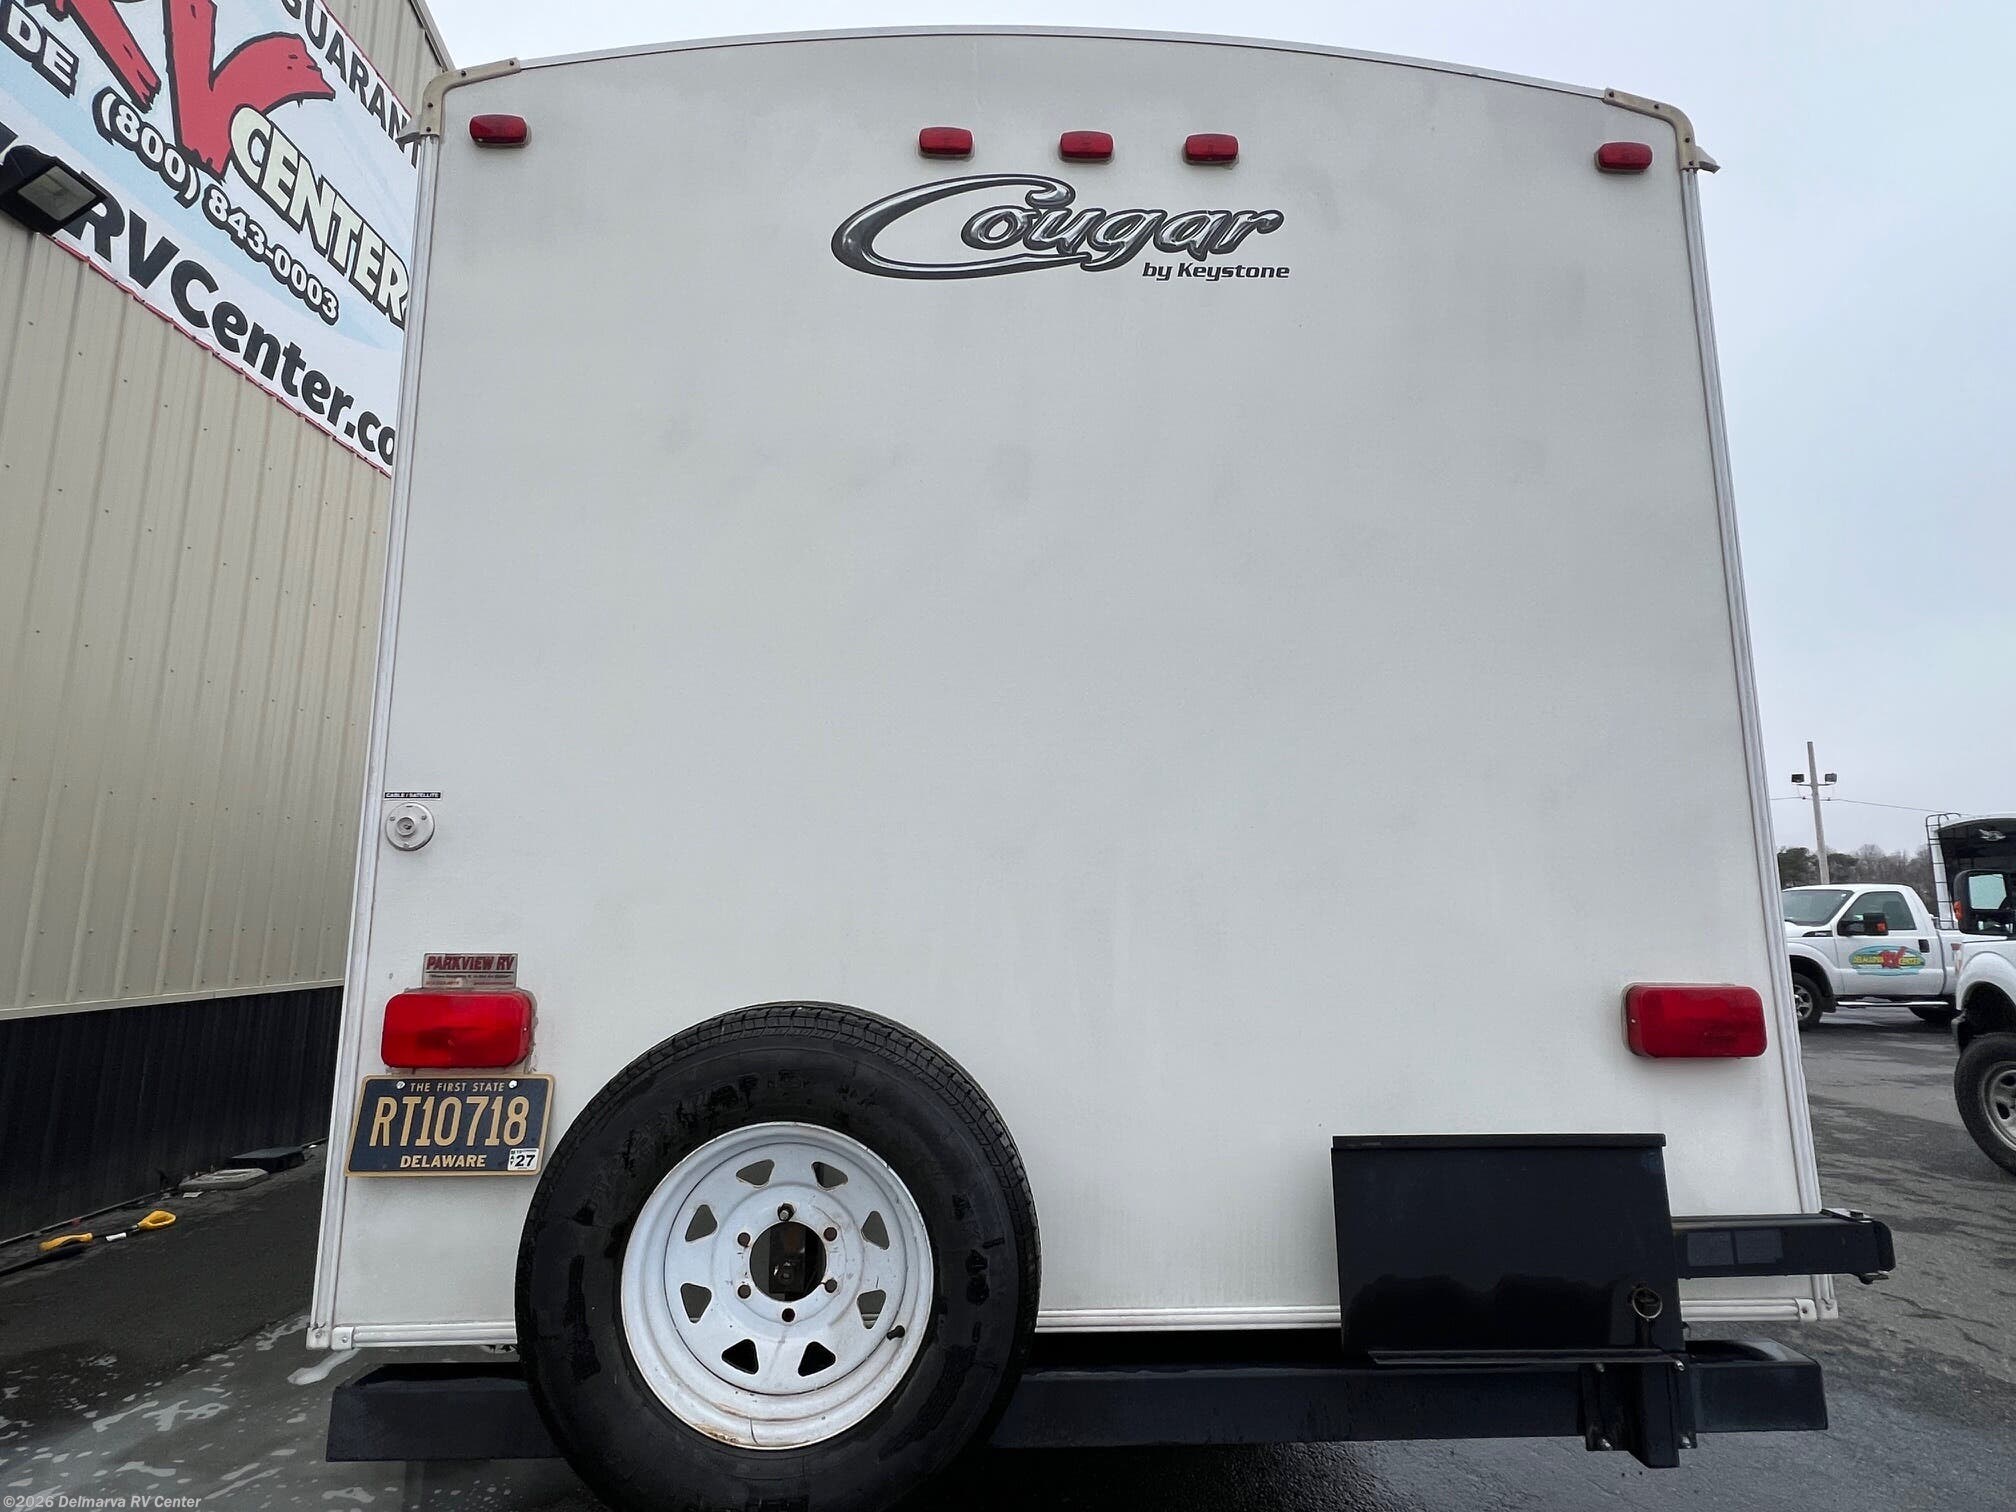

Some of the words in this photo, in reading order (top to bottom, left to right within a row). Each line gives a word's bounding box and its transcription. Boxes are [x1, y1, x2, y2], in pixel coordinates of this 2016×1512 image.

[95, 88, 200, 206] (800)
[203, 185, 339, 323] 843-0003
[229, 104, 408, 328] CENTER
[831, 174, 1284, 280] Cougar
[1143, 262, 1172, 282] by
[1177, 262, 1290, 282] Keystone
[426, 956, 495, 970] PARKVIEW
[496, 956, 515, 970] RV
[410, 1082, 430, 1092] THE
[436, 1082, 466, 1092] FIRST
[472, 1082, 505, 1092] STATE
[369, 1096, 530, 1147] RT10718
[400, 1154, 487, 1168] DELAWARE
[515, 1154, 536, 1167] 27
